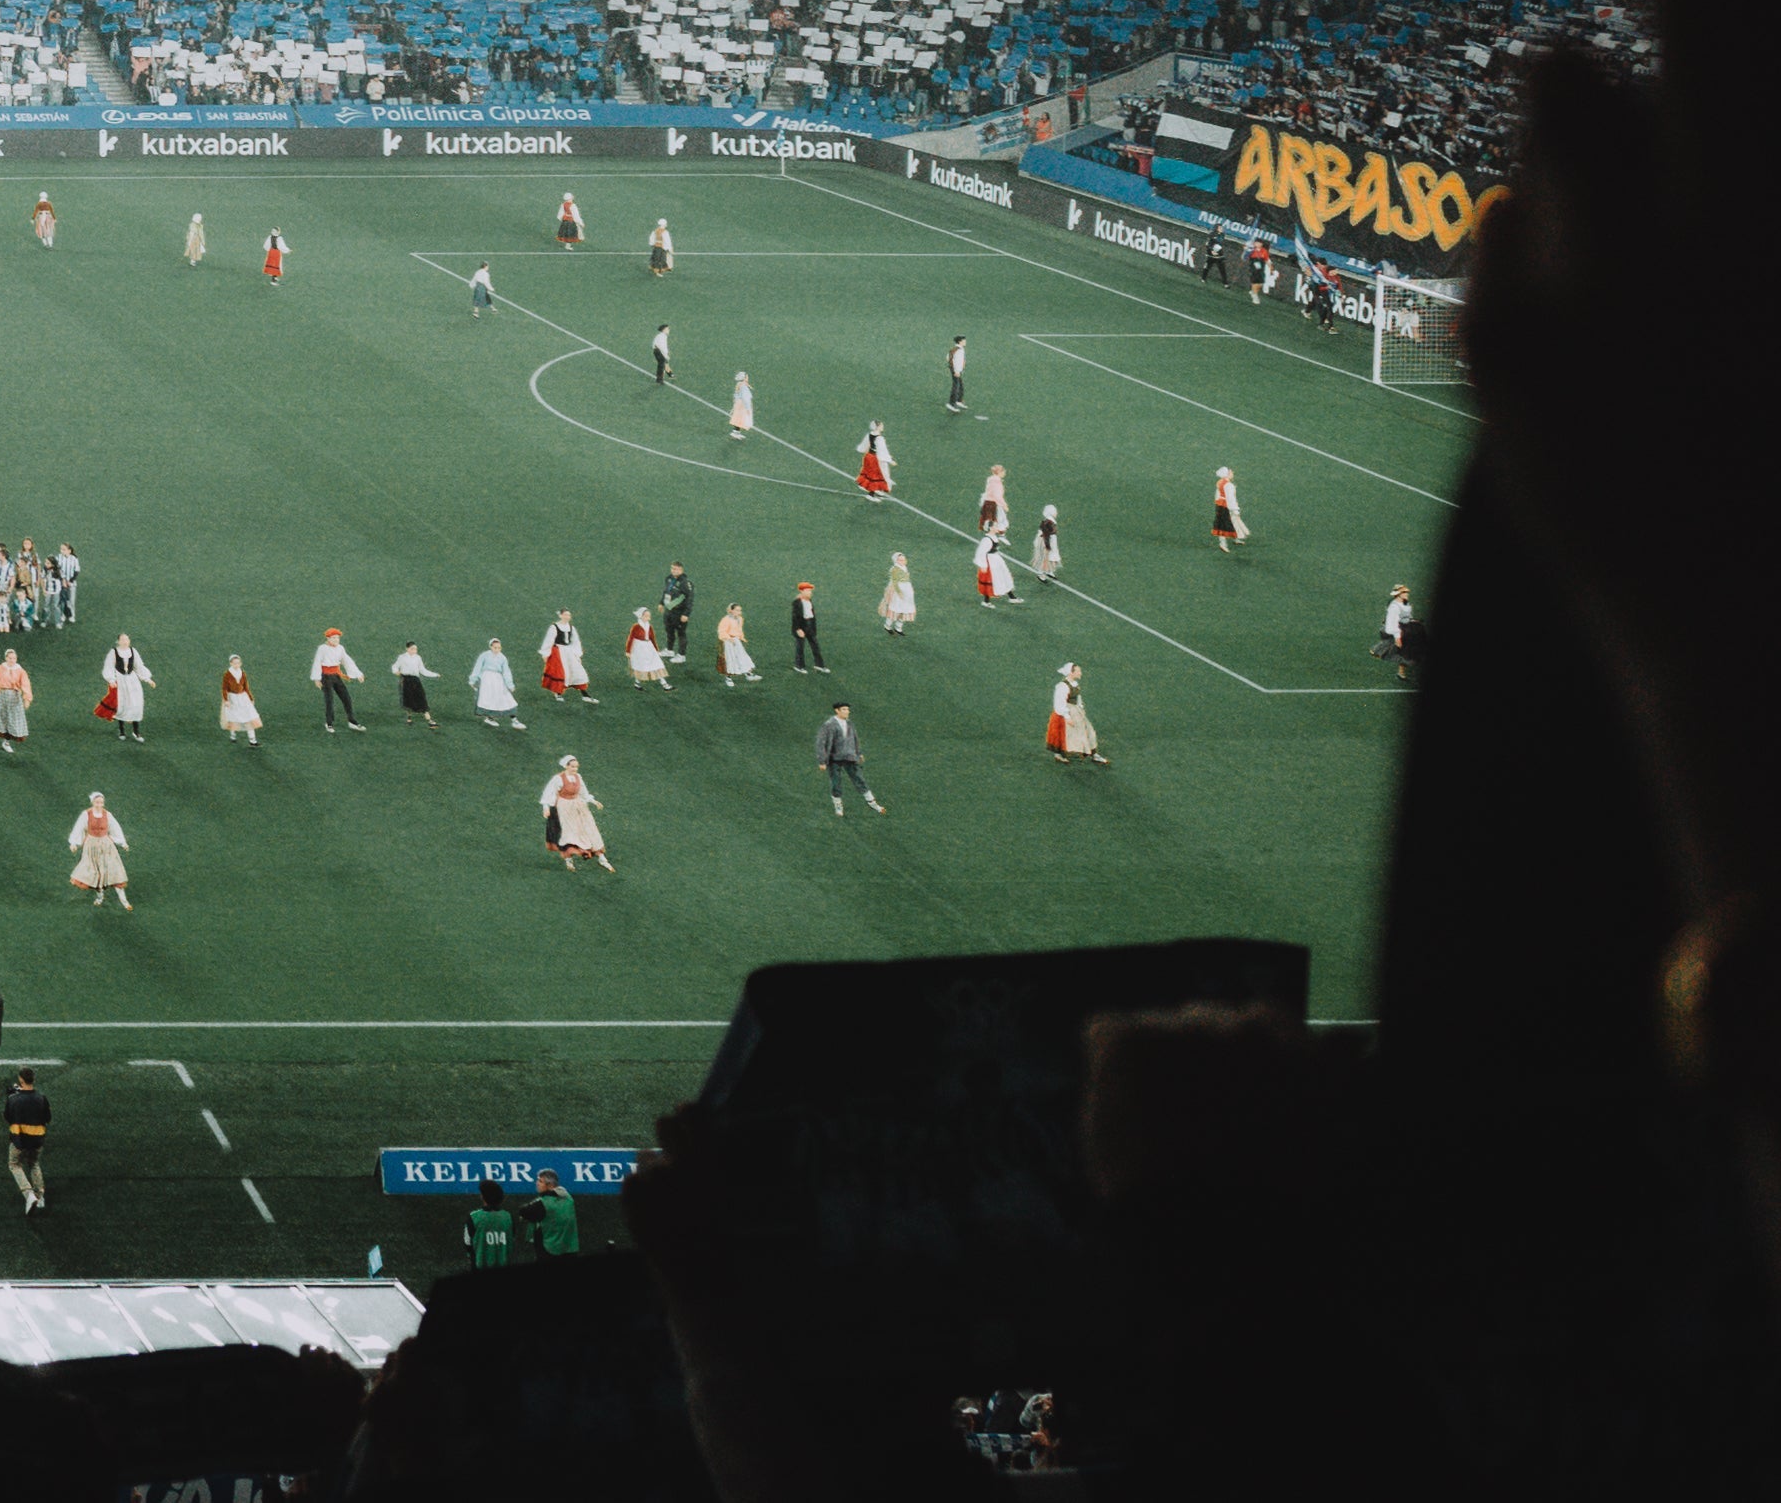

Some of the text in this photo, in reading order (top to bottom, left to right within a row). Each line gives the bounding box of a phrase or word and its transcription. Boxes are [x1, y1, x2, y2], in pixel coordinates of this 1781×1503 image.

[14, 111, 70, 123] SEBASTIÁN
[205, 111, 229, 121] SAN
[232, 110, 289, 121] SEBASTIÁN
[371, 105, 592, 124] Policlínica Gipuzkoa
[141, 132, 288, 156] kutxabank
[425, 130, 573, 155] kutxabank
[711, 131, 857, 163] kutxabank
[930, 159, 1013, 209] kutxabank
[1093, 210, 1196, 269] kutxabank
[402, 1161, 535, 1183] KELER
[485, 1230, 507, 1246] 014
